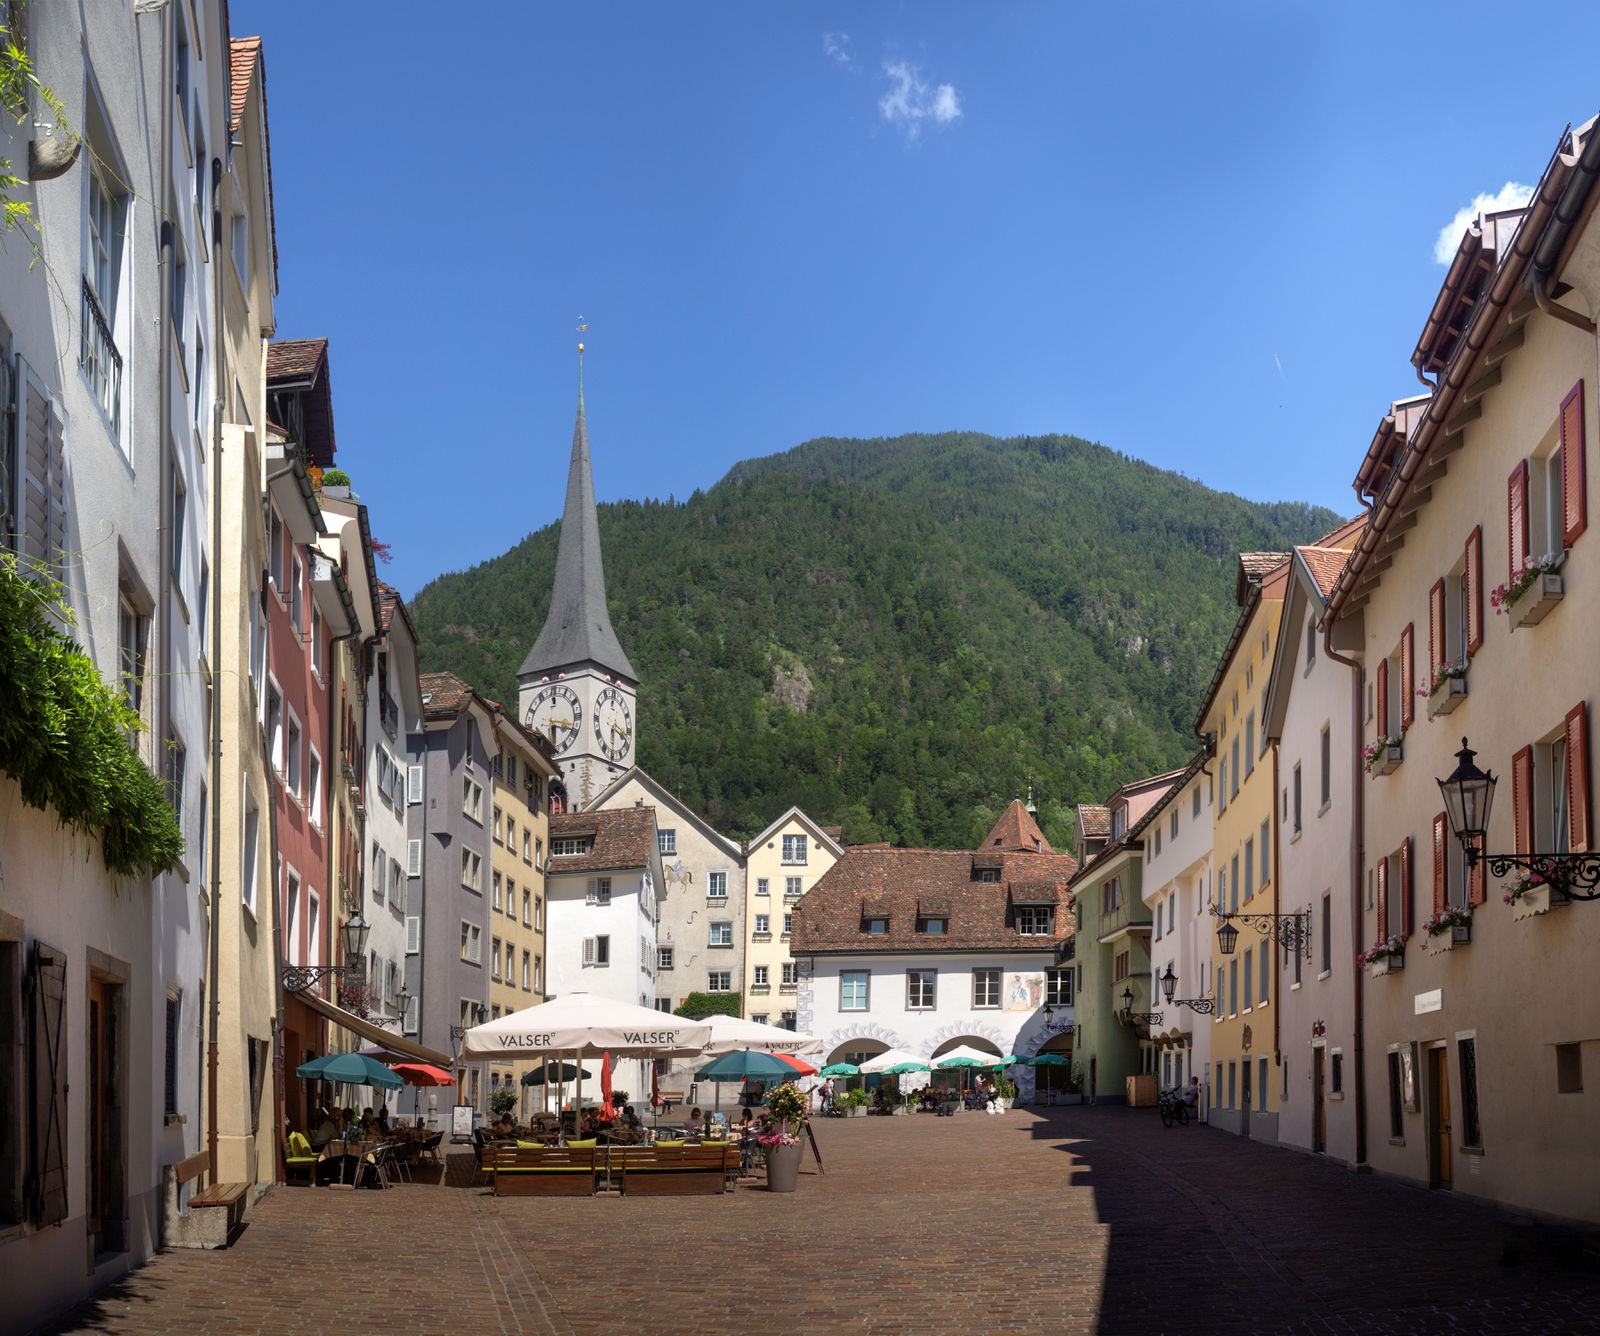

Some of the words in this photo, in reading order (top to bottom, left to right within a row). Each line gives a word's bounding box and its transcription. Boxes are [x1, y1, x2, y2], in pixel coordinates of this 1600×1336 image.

[498, 1034, 551, 1047] VALSER
[623, 1032, 675, 1044] VALSER
[770, 1042, 801, 1050] VALSER
